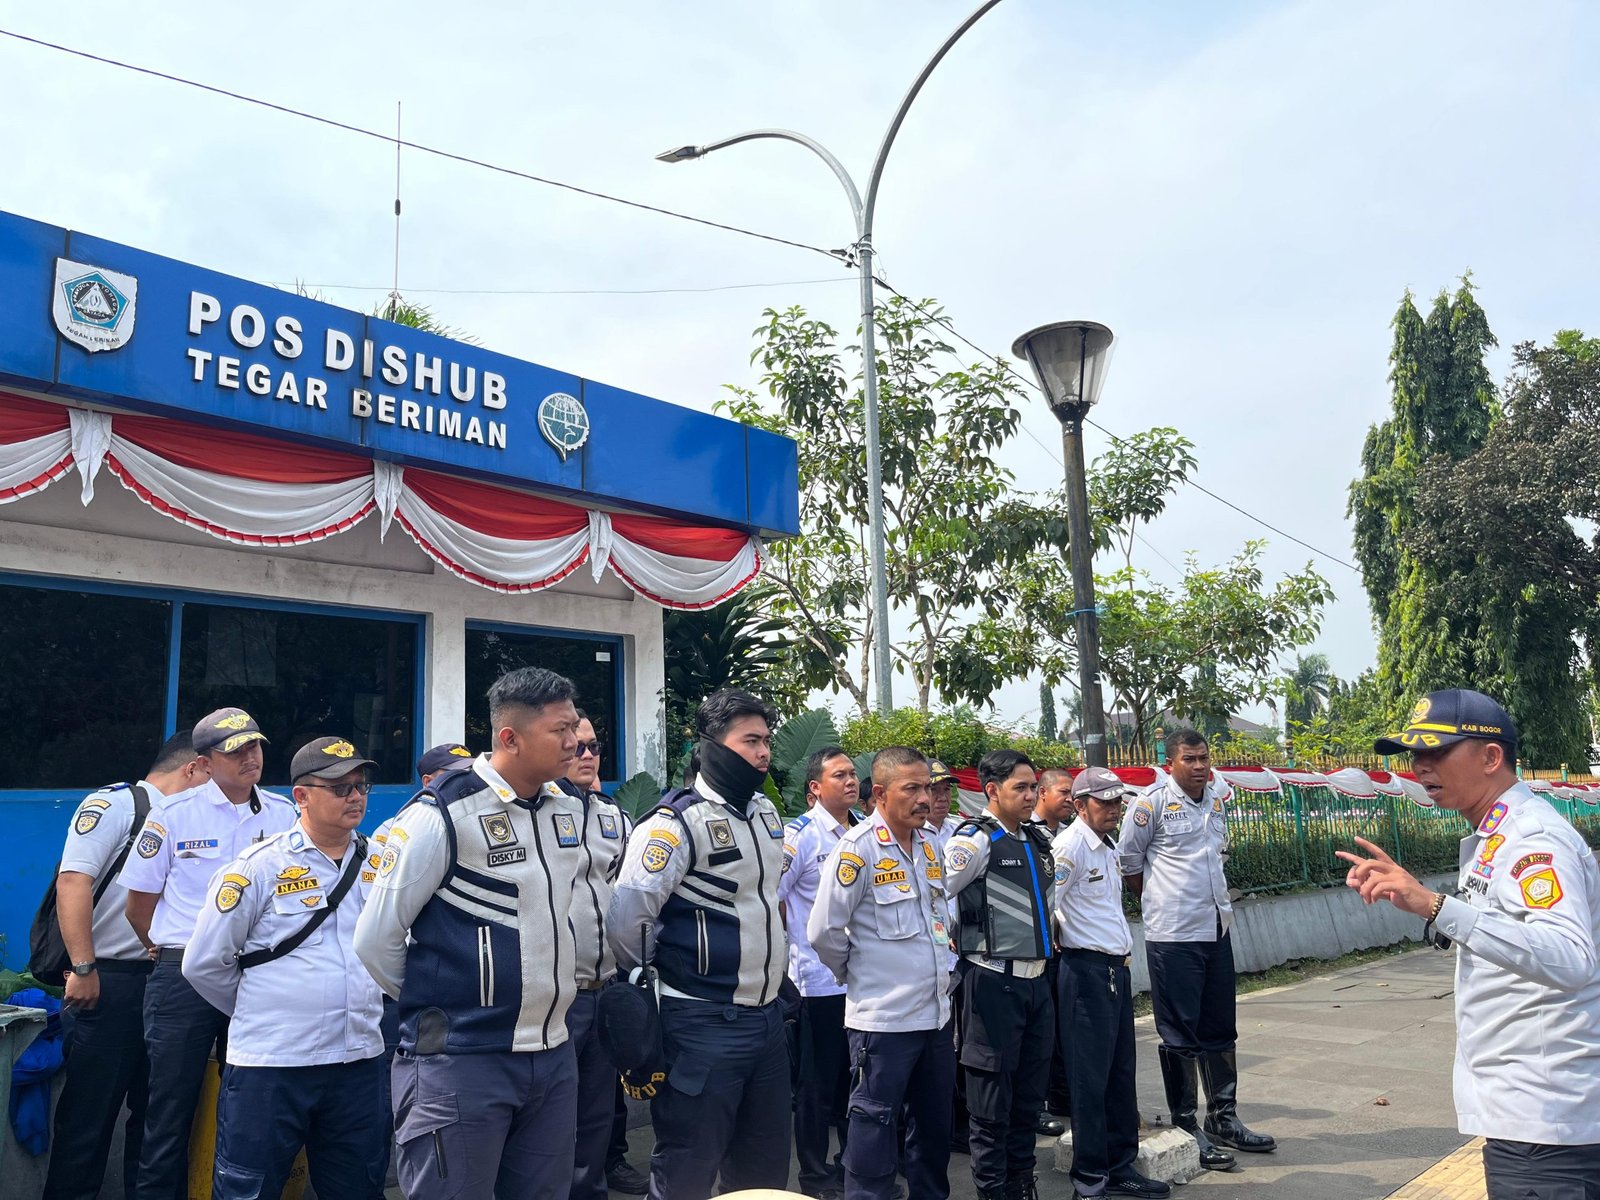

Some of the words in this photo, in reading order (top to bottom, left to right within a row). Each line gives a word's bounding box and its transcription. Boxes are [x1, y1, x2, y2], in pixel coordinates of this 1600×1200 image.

[189, 291, 303, 358] POS
[325, 328, 507, 410] DISHUB
[187, 348, 328, 409] TEGAR
[353, 388, 507, 449] BERIMAN
[1461, 723, 1477, 732] KAB
[1479, 725, 1501, 733] BOGOR
[184, 839, 211, 849] RIZAL
[491, 850, 515, 864] DISKY
[877, 871, 906, 883] UMAR
[281, 880, 316, 894] NANA
